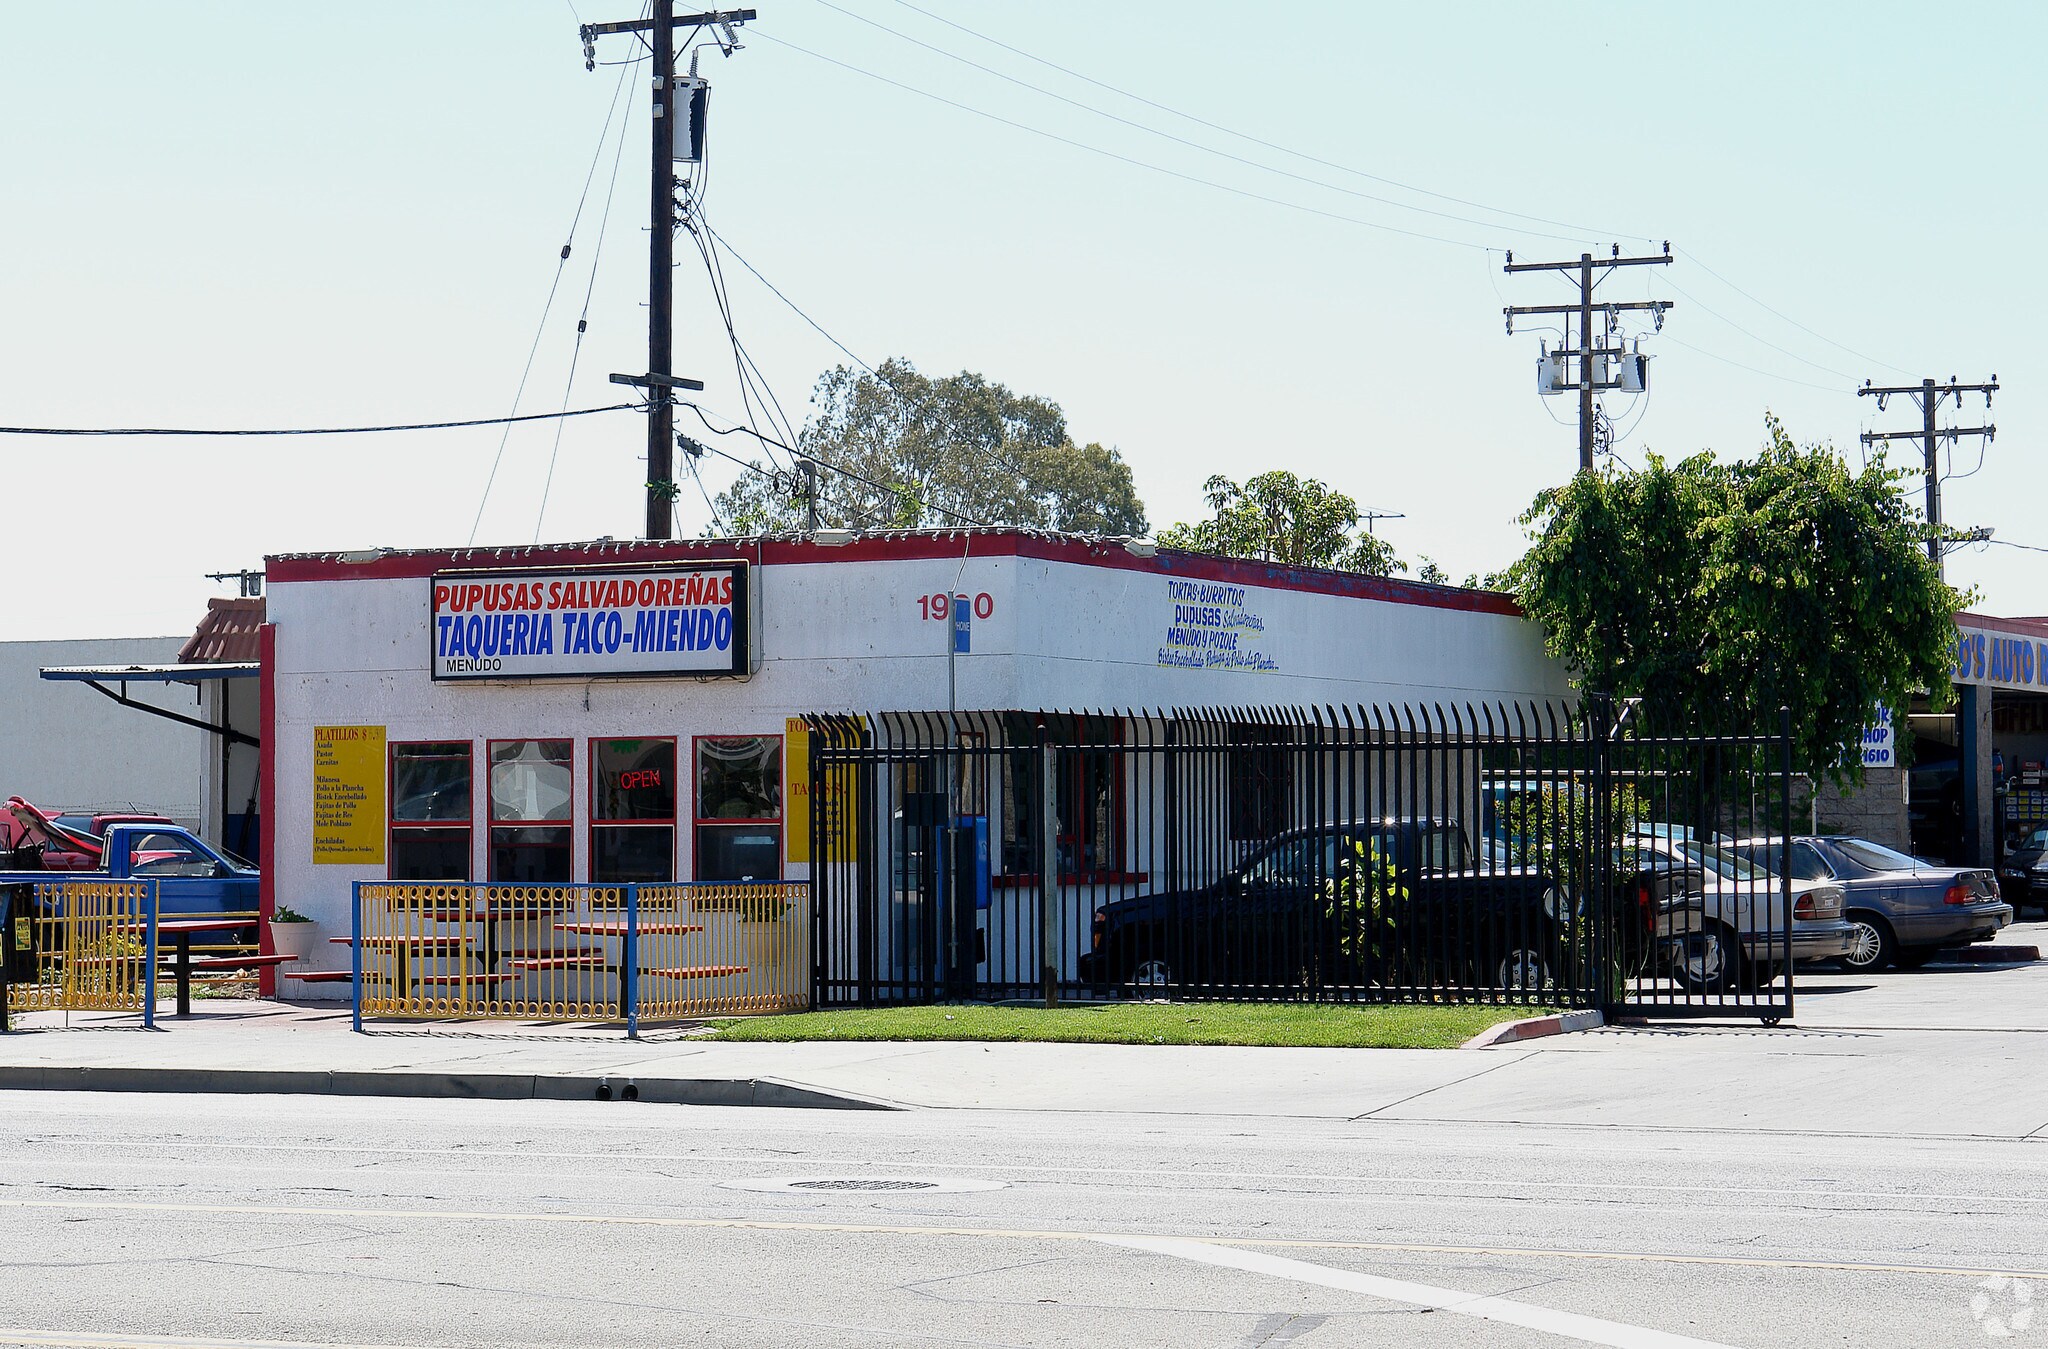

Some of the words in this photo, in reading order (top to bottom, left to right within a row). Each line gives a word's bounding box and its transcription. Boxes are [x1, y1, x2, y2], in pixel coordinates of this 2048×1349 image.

[434, 582, 544, 612] PUPUSAS
[547, 573, 732, 610] SALVADOREÑAS
[917, 593, 993, 620] 190
[438, 613, 553, 659] TAQUERIA
[562, 607, 732, 654] TACO-MIENDO
[1167, 628, 1201, 648] MENUDO
[1209, 631, 1238, 651] POZOLE
[446, 658, 502, 672] MENUDO
[1988, 638, 2034, 684] AUTO
[315, 728, 358, 741] PLATILLOS
[1863, 727, 1888, 743] HOP
[621, 770, 661, 789] OPEN
